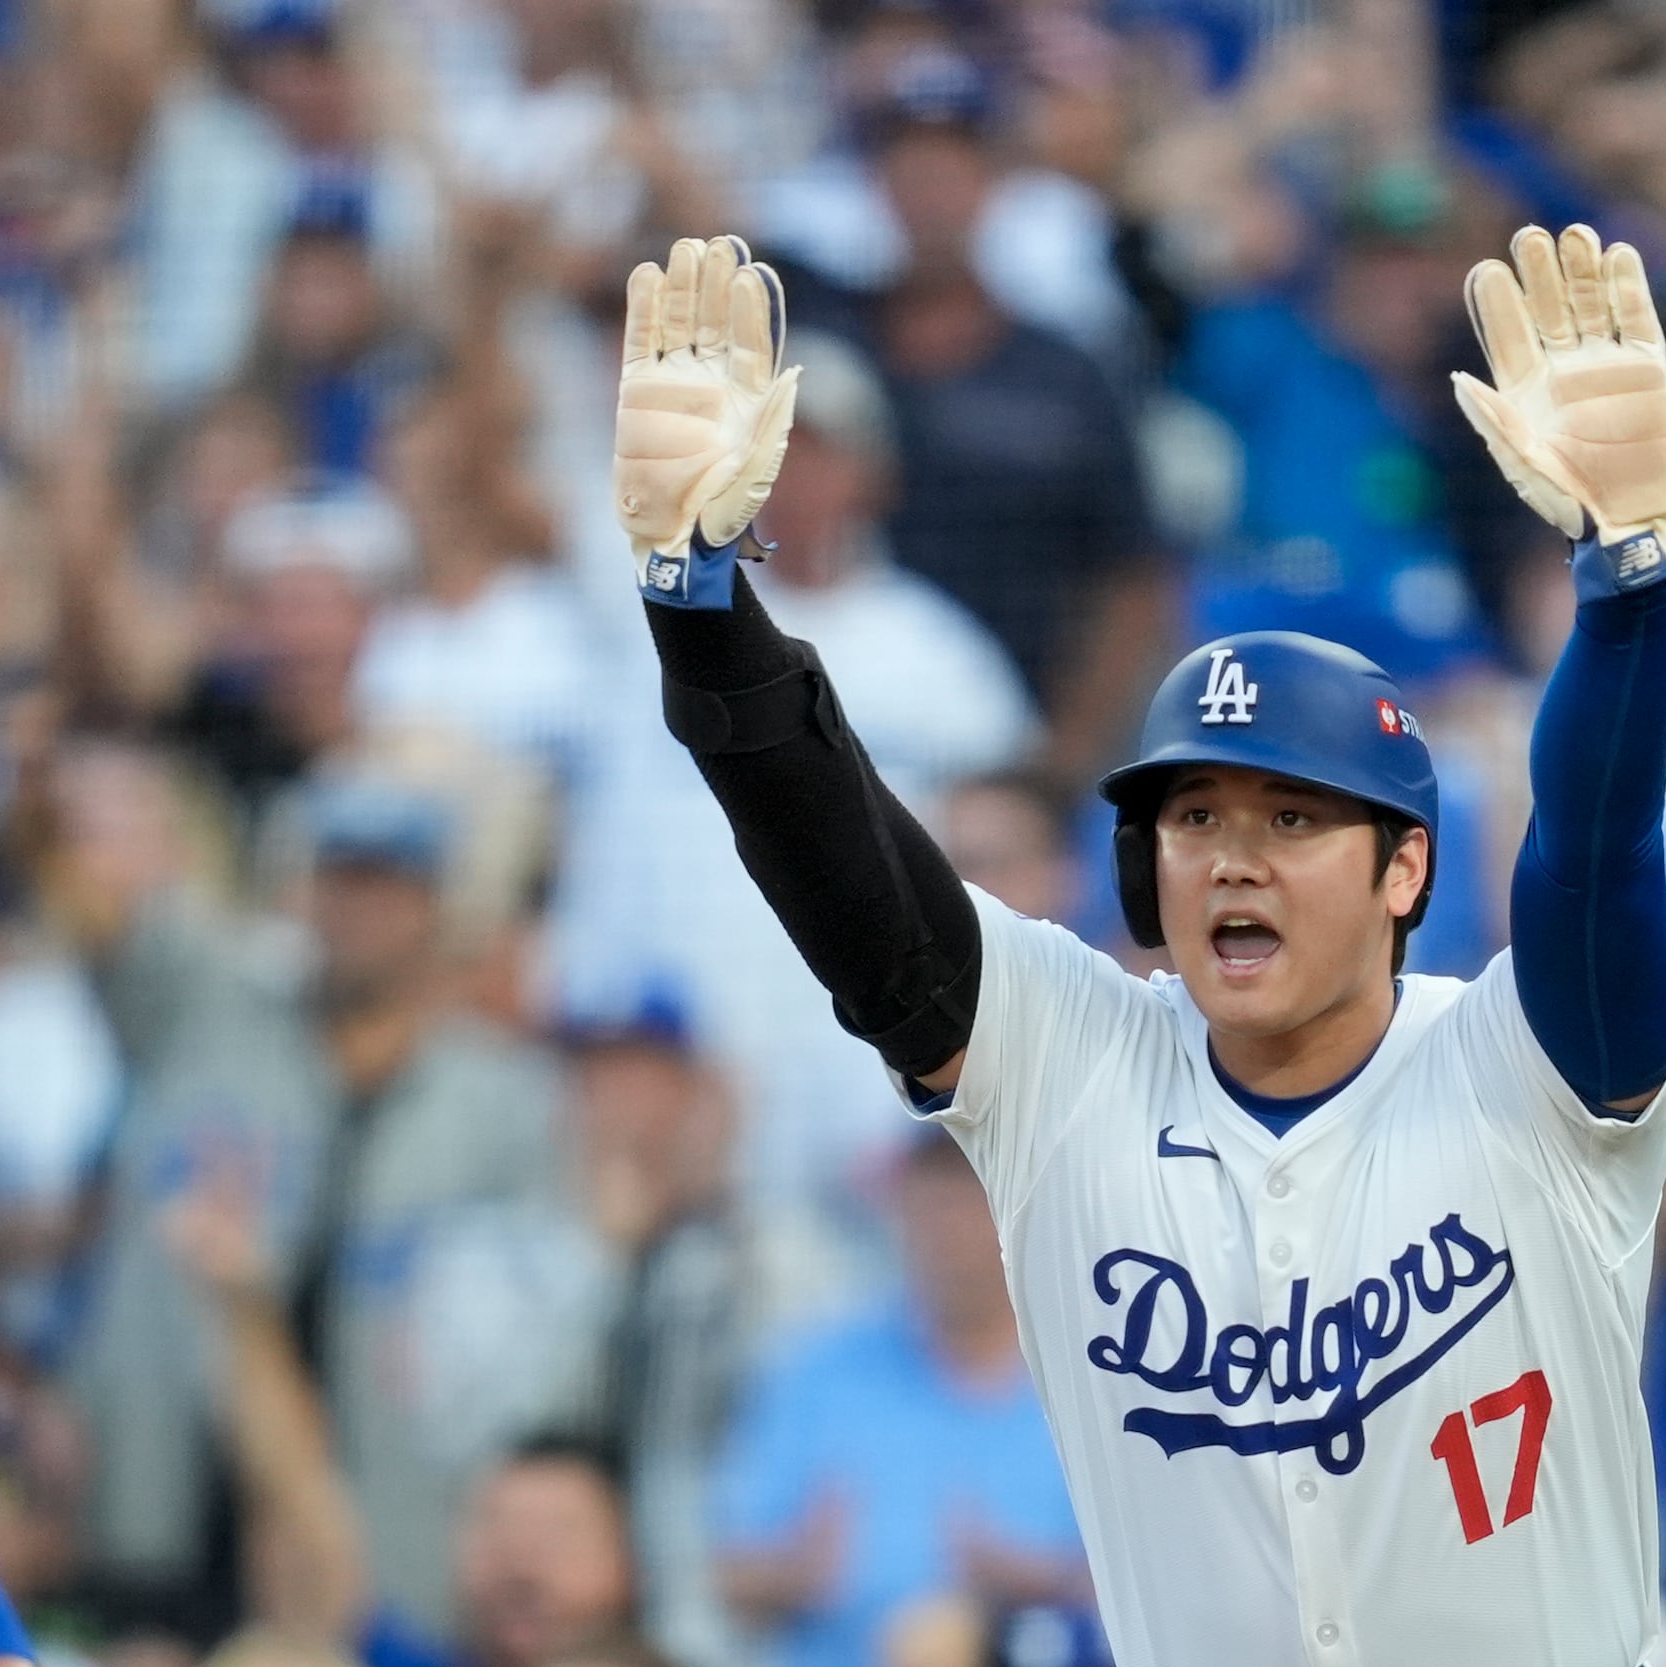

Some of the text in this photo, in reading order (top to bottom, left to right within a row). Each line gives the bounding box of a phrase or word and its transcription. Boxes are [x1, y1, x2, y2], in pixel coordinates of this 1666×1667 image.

[1198, 648, 1258, 724] LA
[1087, 1213, 1515, 1475] Dodgers
[1430, 1369, 1553, 1545] 17
